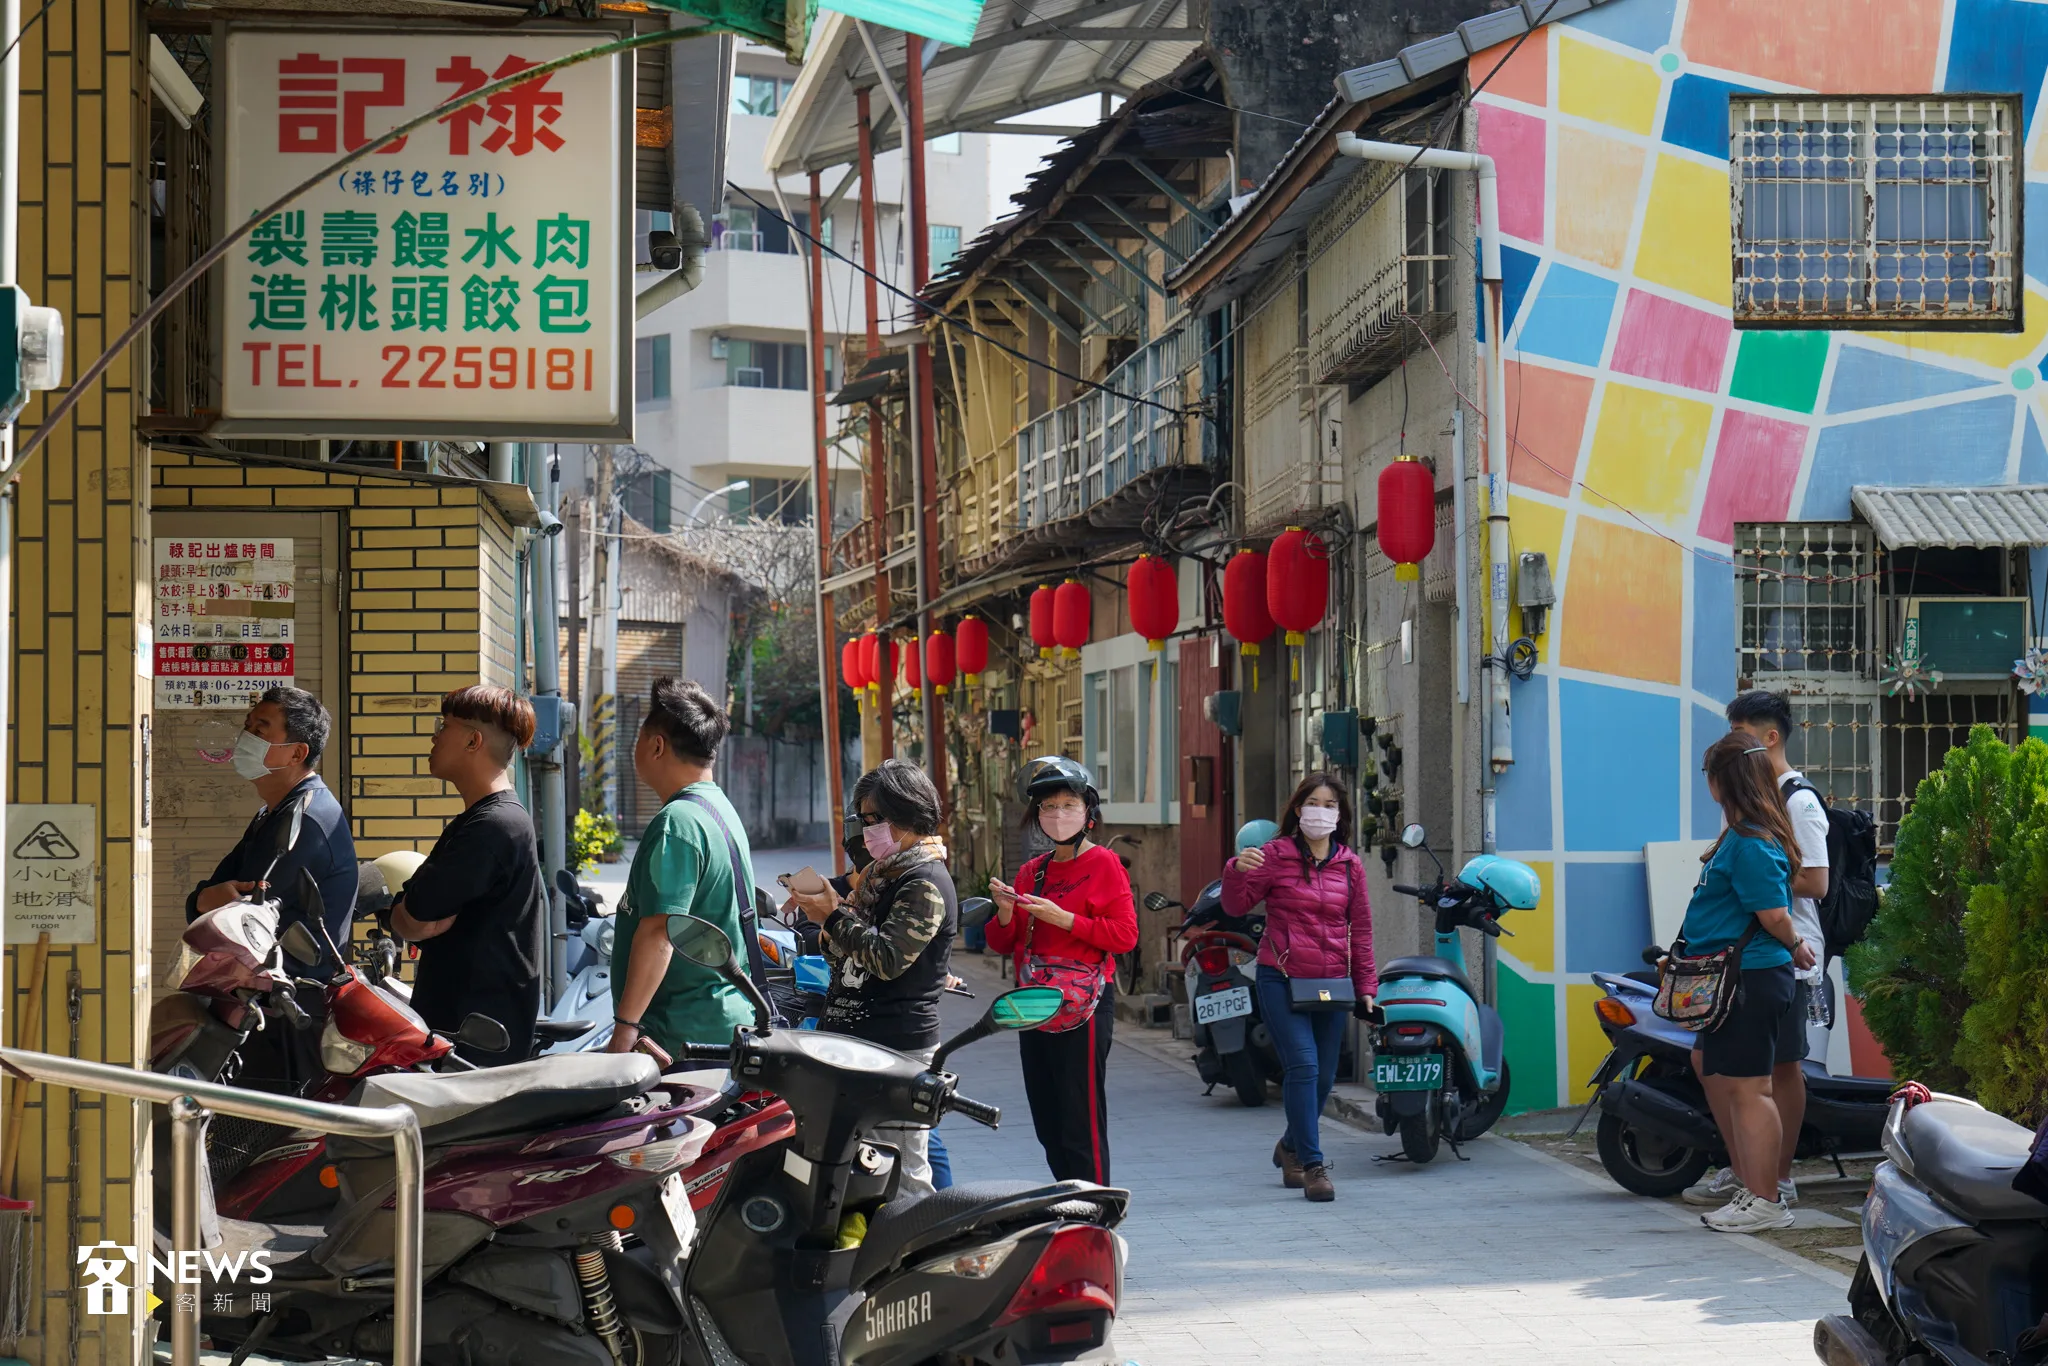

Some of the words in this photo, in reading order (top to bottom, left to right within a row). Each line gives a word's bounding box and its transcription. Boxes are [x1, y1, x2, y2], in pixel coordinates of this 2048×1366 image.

[381, 345, 593, 391] 2259181
[169, 542, 275, 559] 祿記出爐時間
[12, 865, 77, 882] 小心
[12, 891, 75, 907] 地滑
